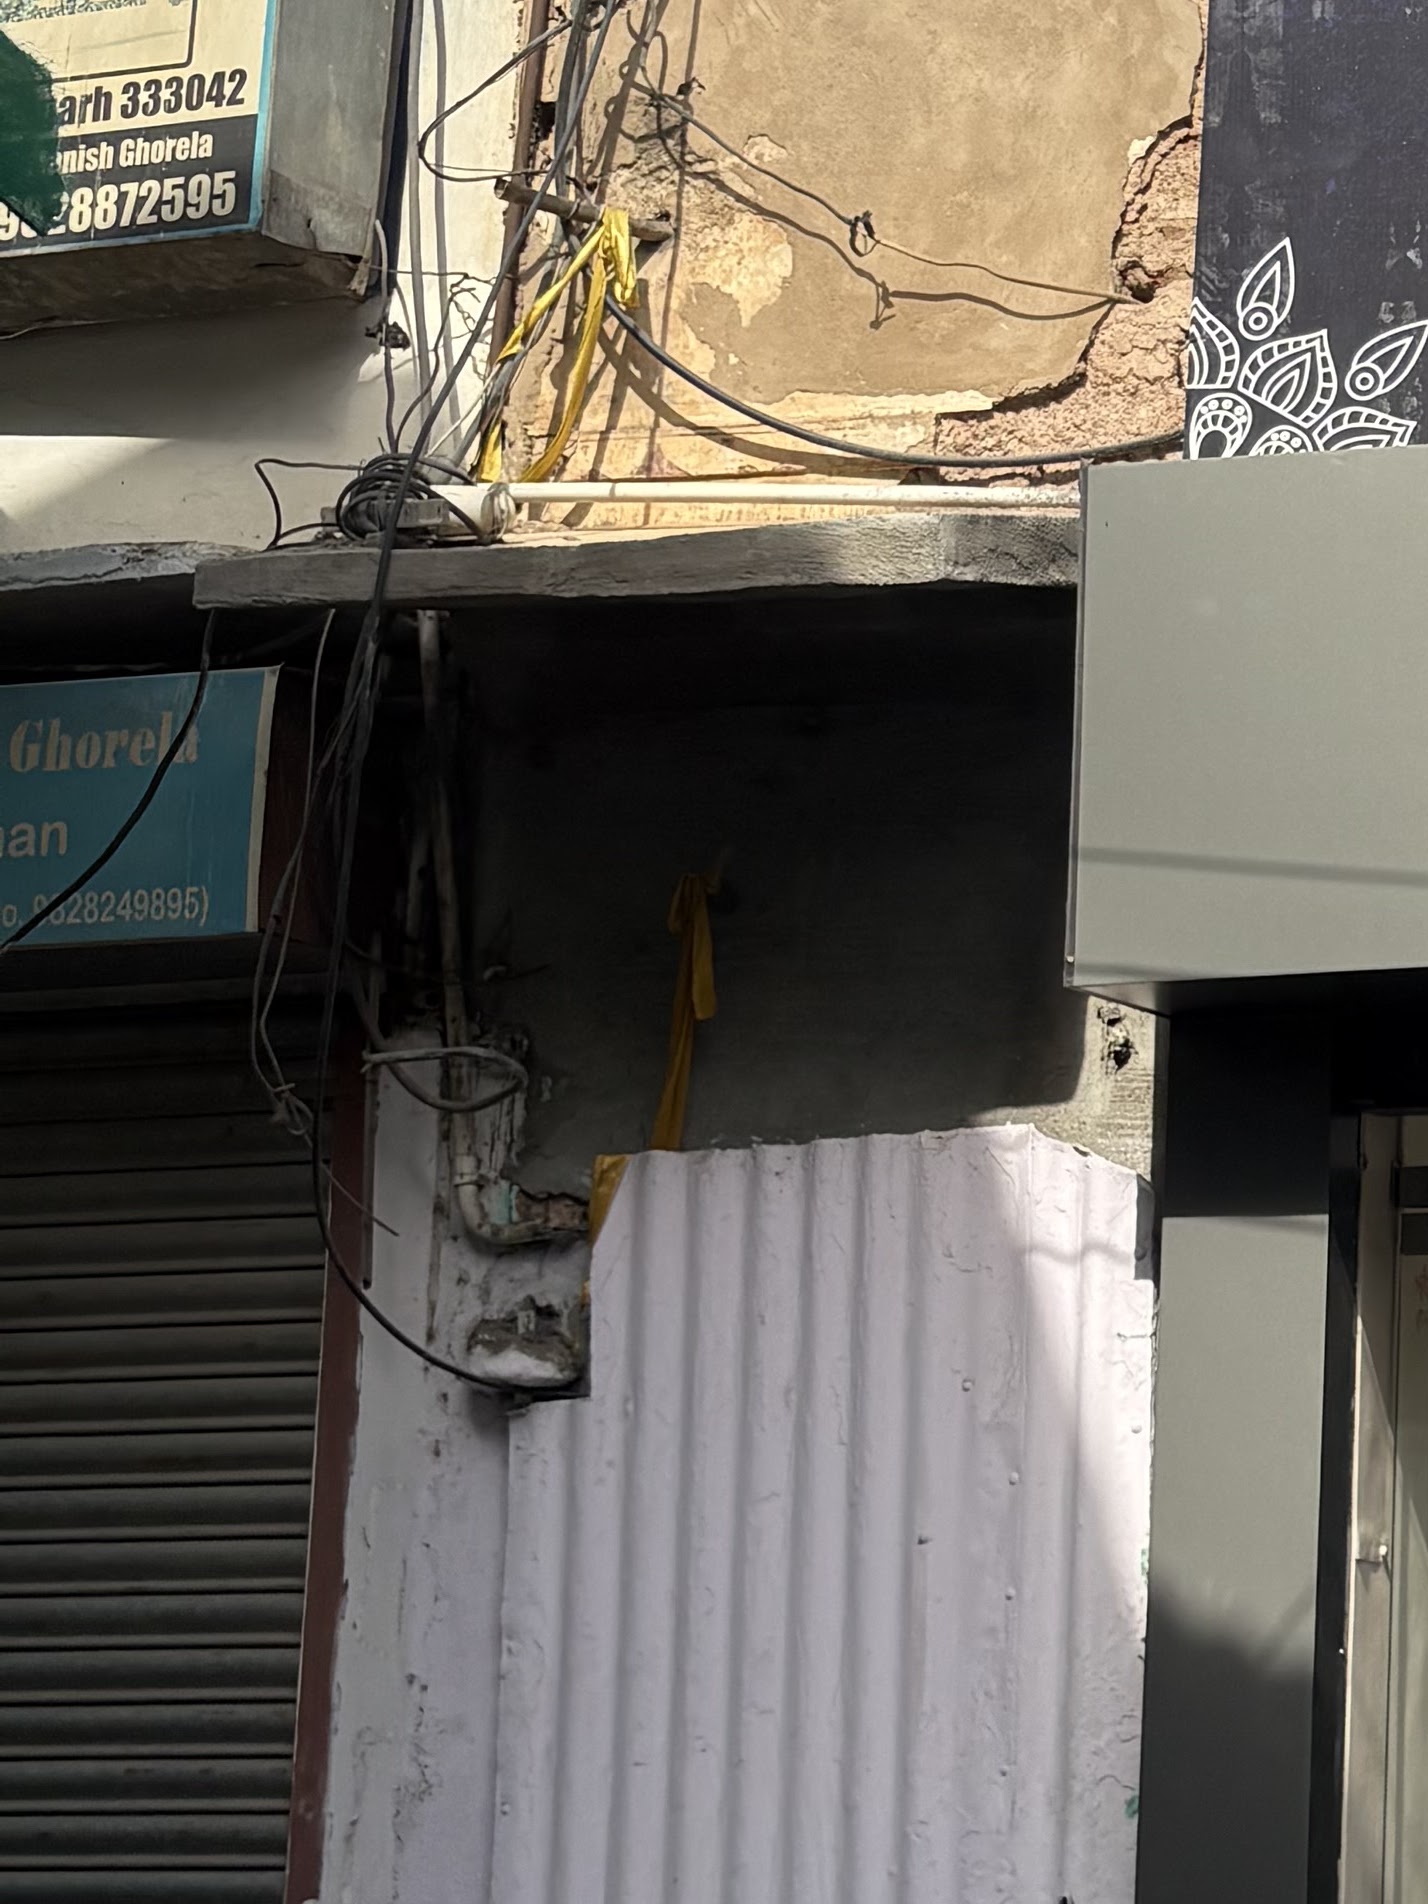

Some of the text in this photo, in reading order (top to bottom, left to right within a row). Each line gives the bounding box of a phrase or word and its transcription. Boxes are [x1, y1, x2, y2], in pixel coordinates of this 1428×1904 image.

[120, 68, 248, 120] 333042
[56, 131, 214, 175] nish Ghorela
[9, 711, 200, 773] Ghorela
